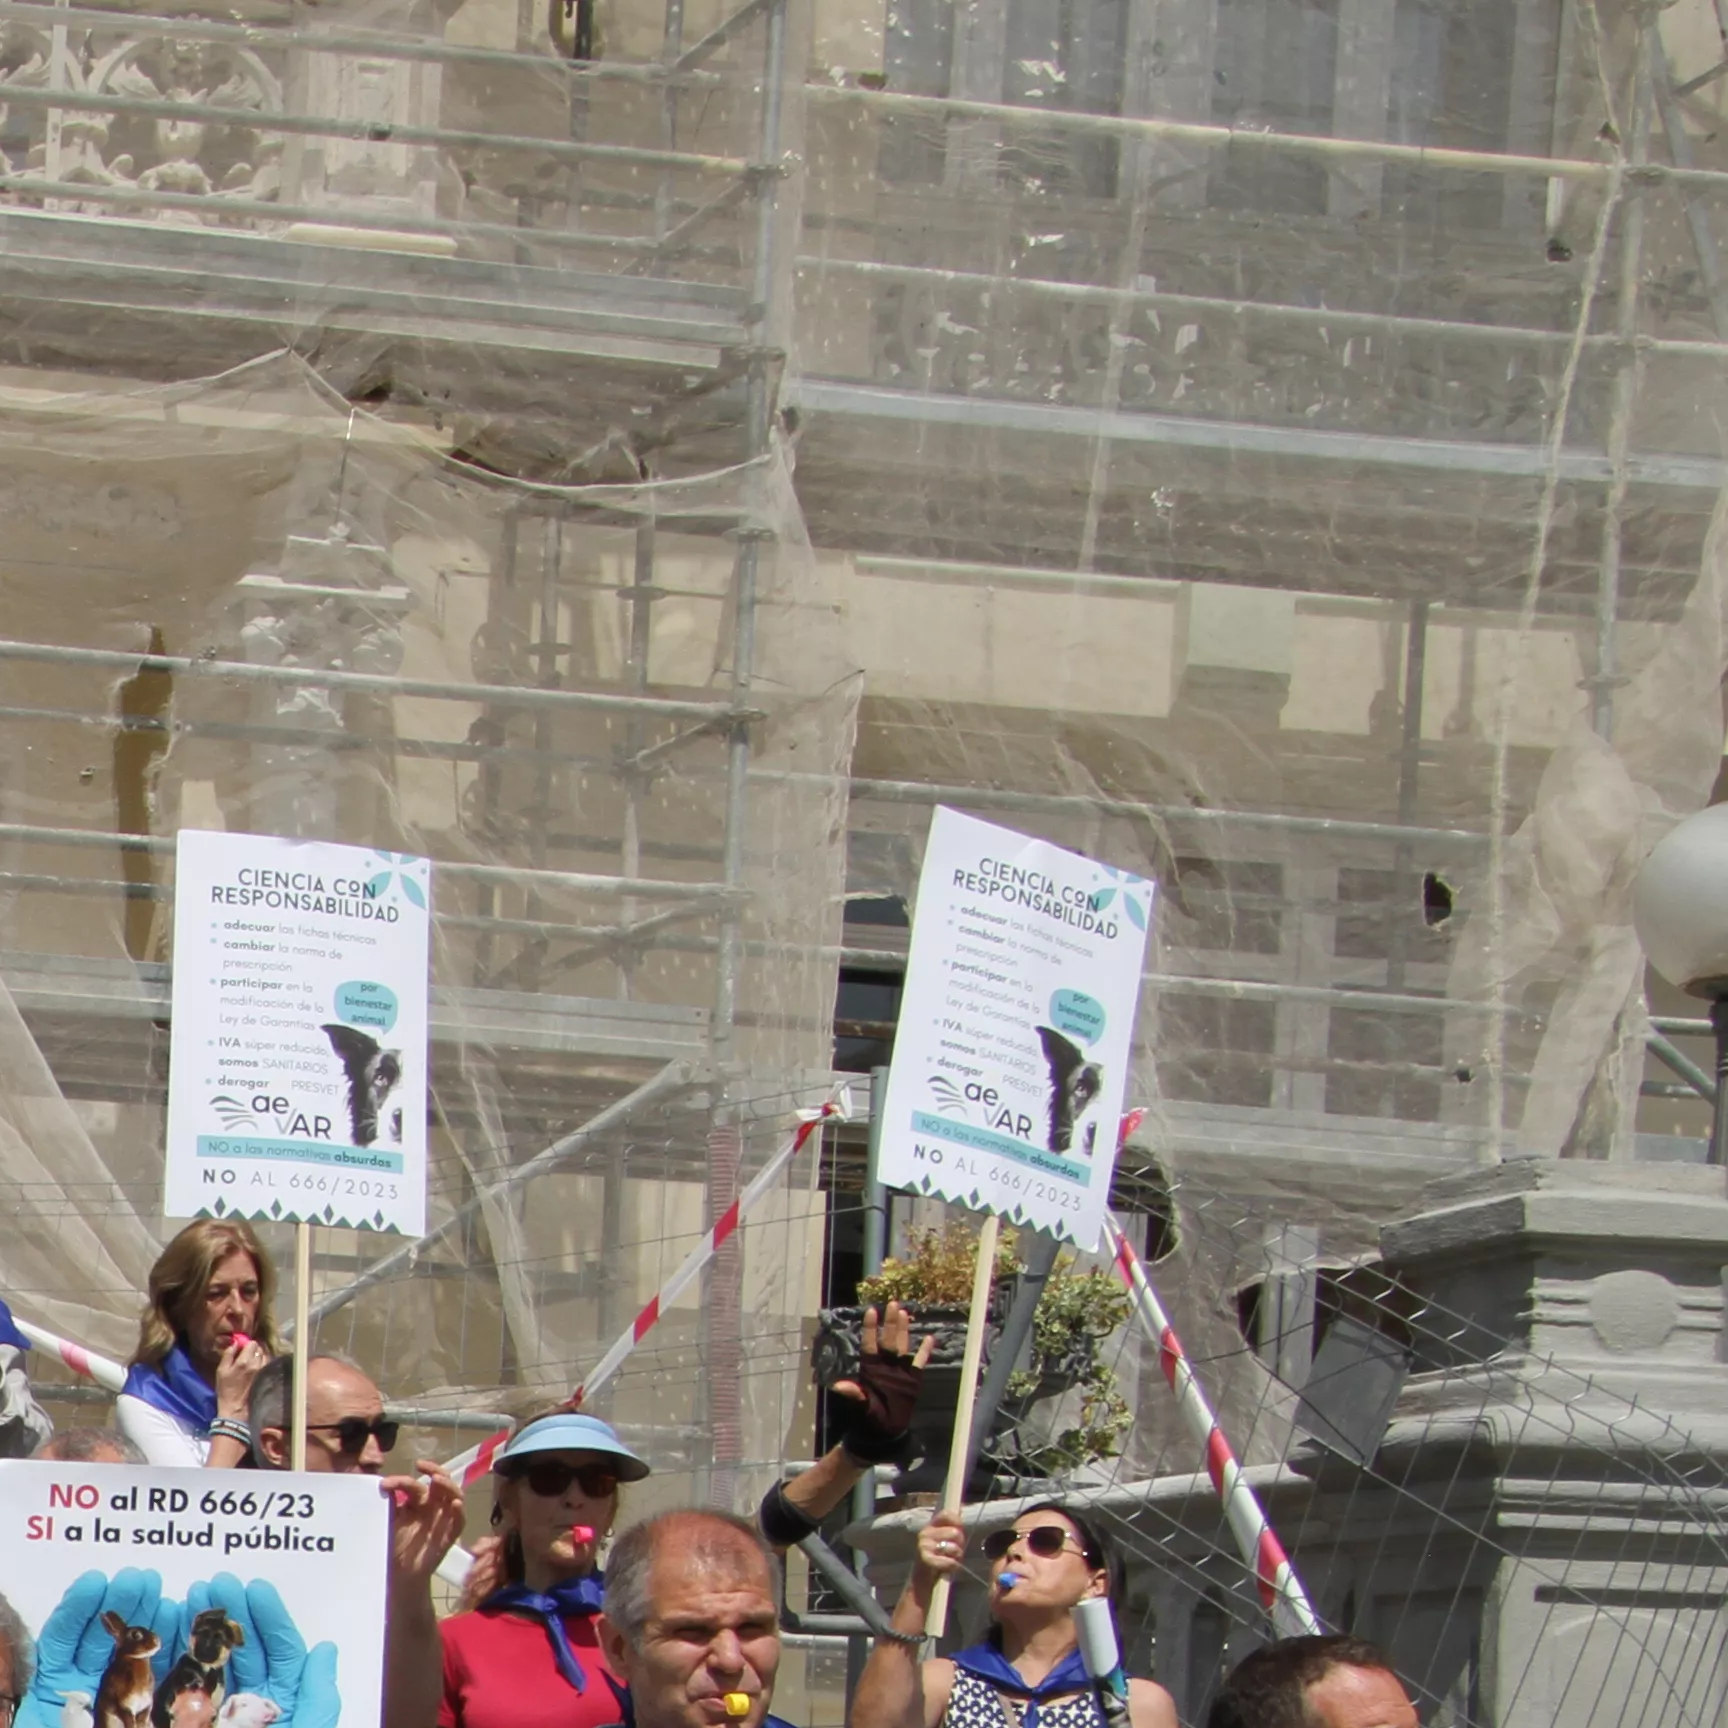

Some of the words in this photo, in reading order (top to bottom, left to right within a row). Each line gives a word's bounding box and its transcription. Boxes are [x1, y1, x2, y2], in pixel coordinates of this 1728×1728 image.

[237, 868, 325, 894] CIENCIA
[979, 857, 1055, 898] CIENCIA
[211, 886, 400, 924] RESPONSABILIDAD
[952, 868, 1118, 940] RESPONSABILIDAD
[223, 919, 276, 934] adecuar
[223, 939, 275, 953] cambiar
[220, 977, 283, 992] participar
[344, 996, 393, 1012] bienestar
[351, 1012, 386, 1026] animal
[218, 1036, 241, 1048] IVA
[218, 1057, 259, 1068] somos
[262, 1059, 329, 1075] SANITARIOS
[217, 1075, 270, 1090] derogar
[290, 1079, 341, 1096] PRESVET
[207, 1140, 230, 1153] NO
[334, 1148, 393, 1169] absurdas
[202, 1168, 237, 1185] NO
[250, 1173, 276, 1187] AL
[289, 1173, 399, 1200] 666/2023
[913, 1143, 944, 1165] NO
[954, 1156, 979, 1176] AL
[988, 1166, 1081, 1212] 666/2023
[48, 1483, 100, 1509] NO
[109, 1486, 138, 1512] al
[148, 1487, 189, 1513] RD
[199, 1490, 315, 1521] 666/23
[25, 1516, 53, 1541] SI
[63, 1525, 84, 1544] a
[94, 1518, 122, 1545] la
[131, 1520, 214, 1548] salud
[223, 1524, 336, 1556] pública
